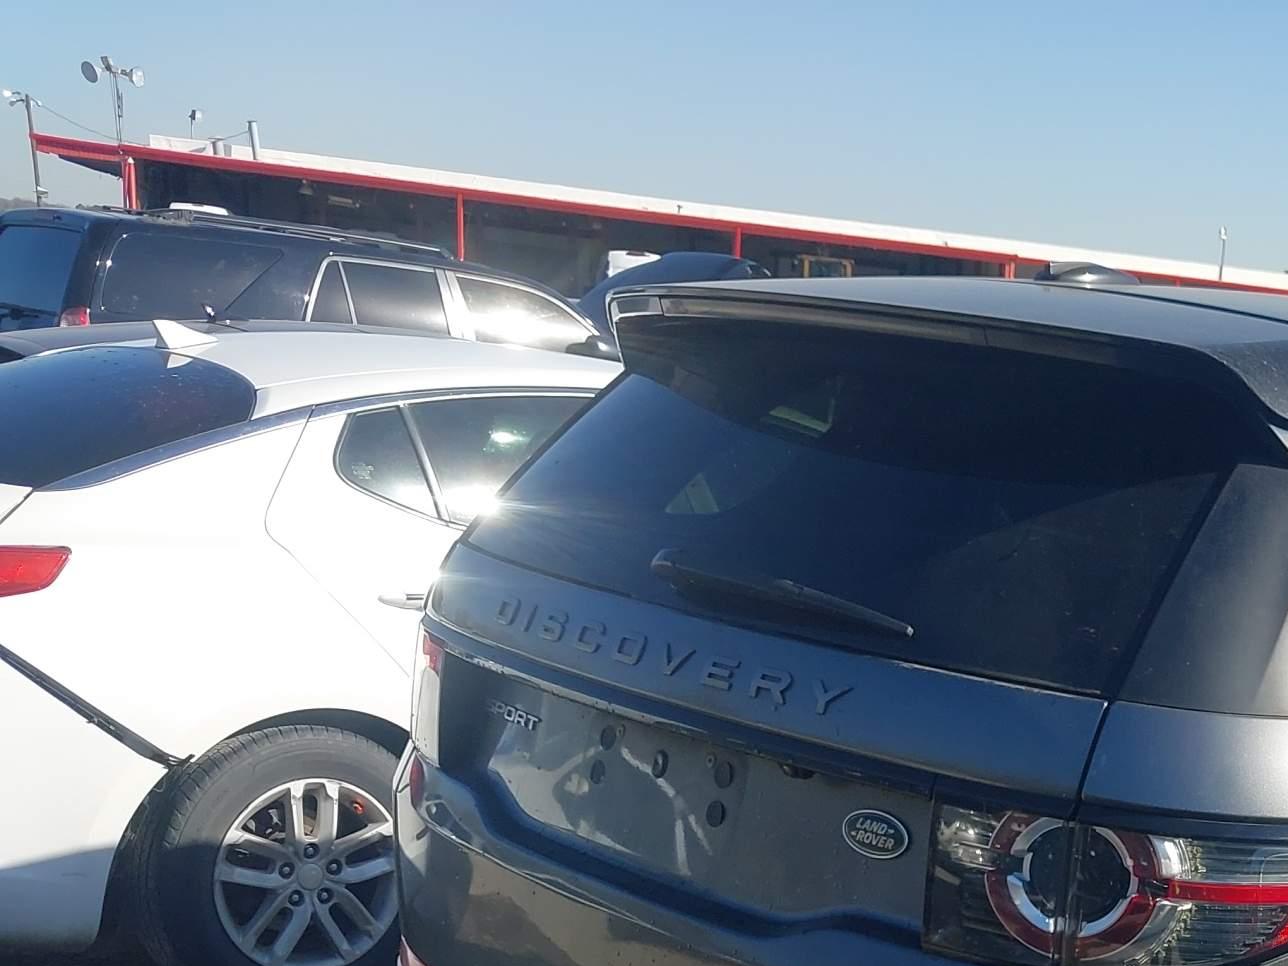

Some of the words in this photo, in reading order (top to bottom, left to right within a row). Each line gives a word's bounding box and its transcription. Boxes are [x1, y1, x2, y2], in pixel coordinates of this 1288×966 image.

[495, 597, 854, 716] DISCOVERY
[856, 817, 888, 835] LAND
[855, 830, 895, 850] ROVER
